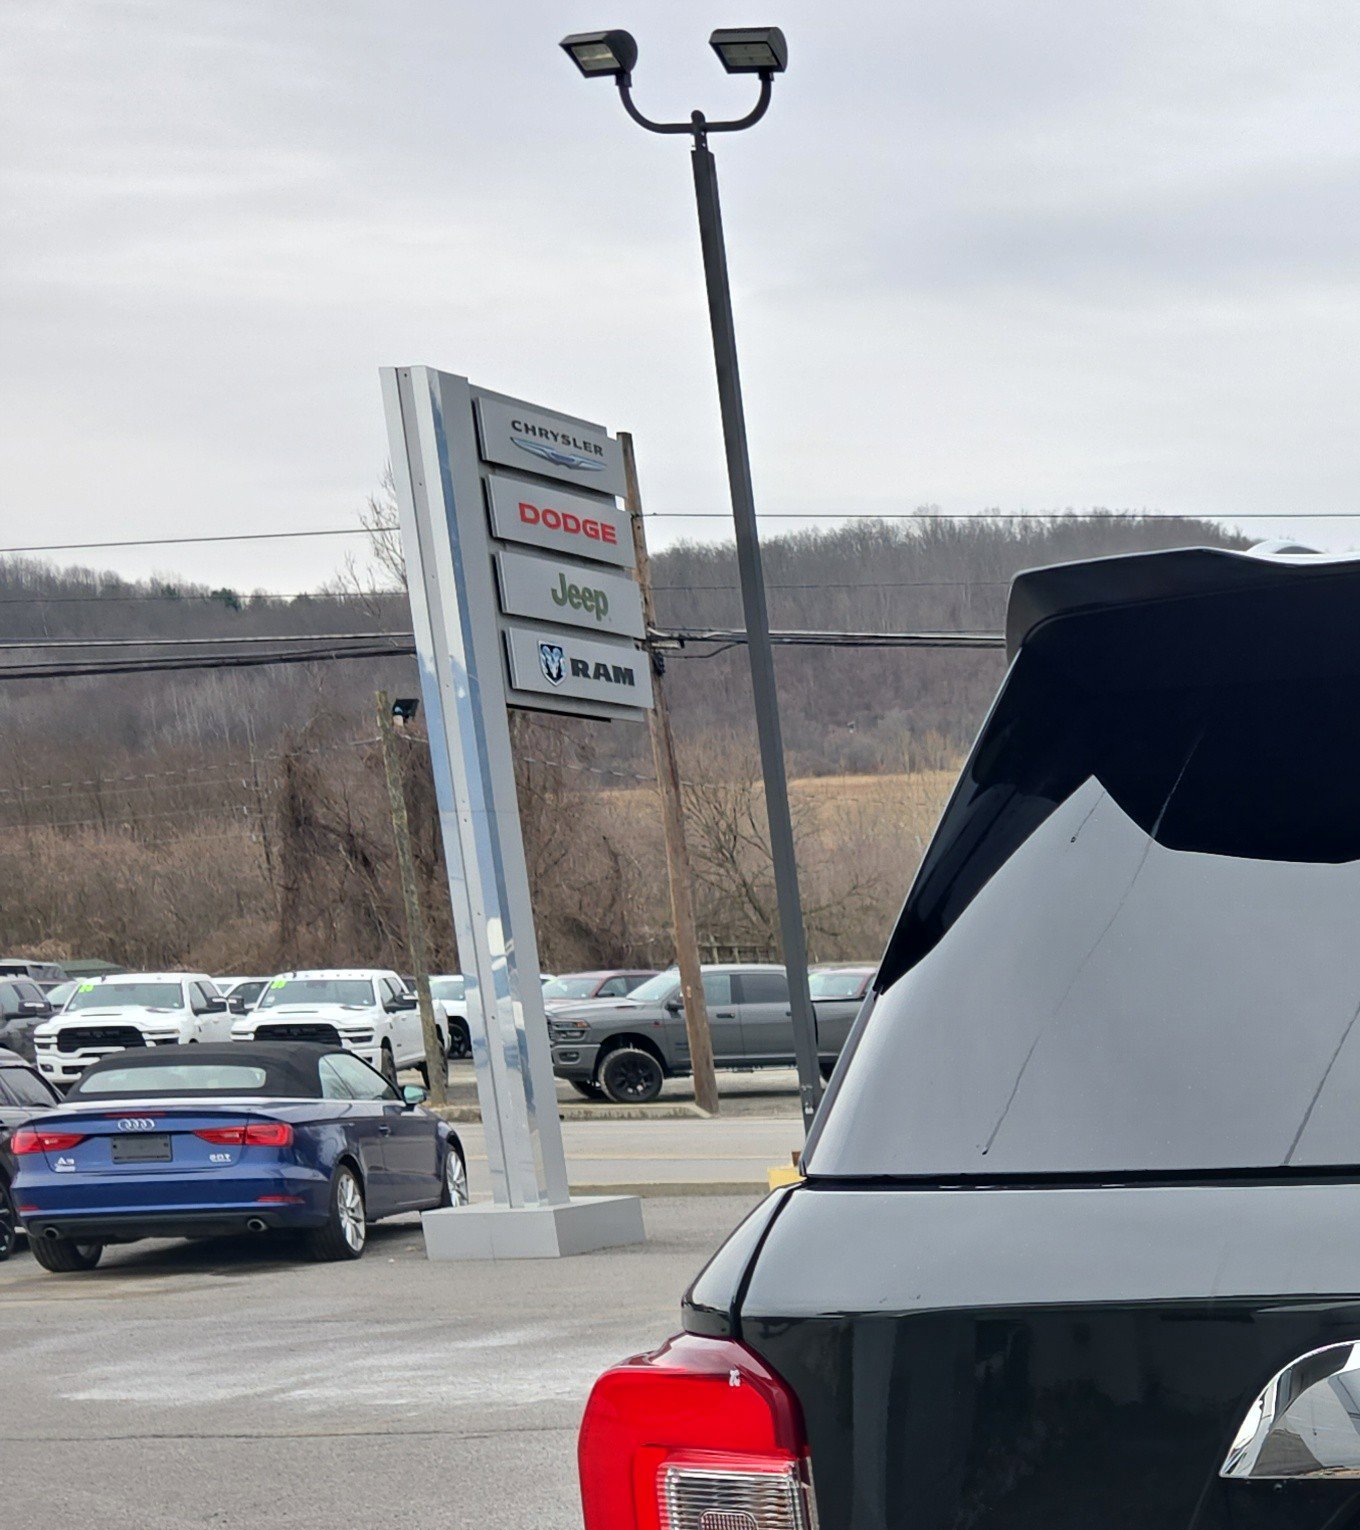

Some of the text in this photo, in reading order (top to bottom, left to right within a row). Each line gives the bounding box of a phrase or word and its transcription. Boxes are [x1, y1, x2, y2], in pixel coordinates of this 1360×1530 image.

[511, 420, 604, 457] CHRYSLER
[518, 502, 618, 545] DODGE
[551, 572, 609, 622] Jeep
[570, 657, 636, 687] RAM
